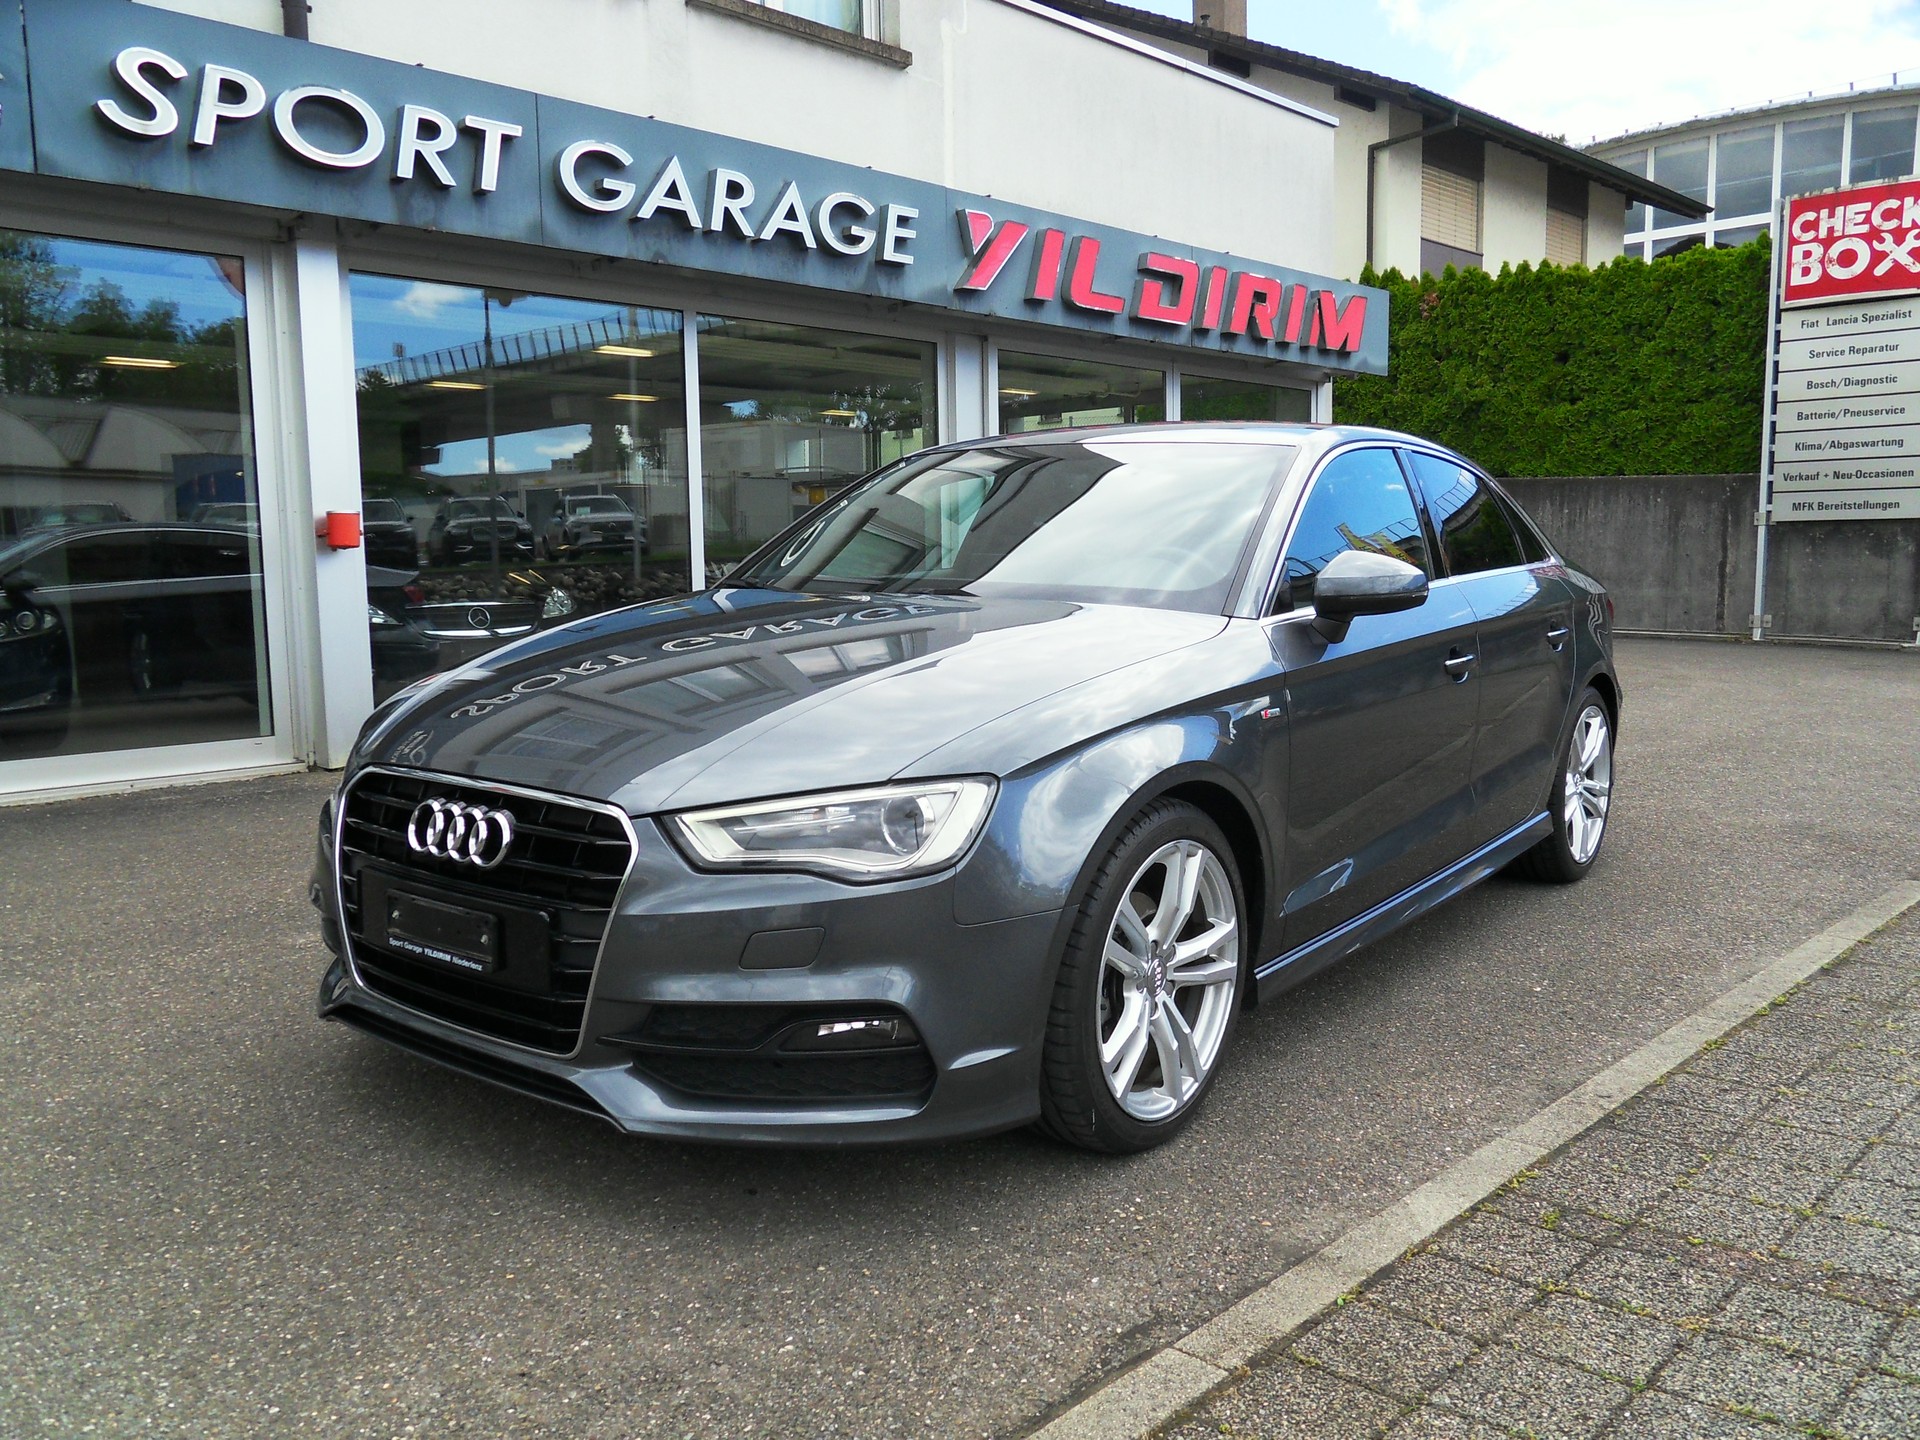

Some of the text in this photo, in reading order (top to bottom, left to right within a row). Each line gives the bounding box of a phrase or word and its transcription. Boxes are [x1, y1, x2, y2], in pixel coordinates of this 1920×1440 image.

[95, 46, 1368, 353] SPORT GARAGE YILDIRIM
[1791, 196, 1920, 242] CHECK
[1800, 309, 1912, 329] Fiat Lancia Spezialist
[1808, 343, 1900, 359] Service Reparatur
[1806, 374, 1898, 390] Bosch/Diagnostic
[1796, 405, 1906, 421] Batterie/Pneuservice
[1794, 438, 1904, 452] Klima/Abgaswartung
[1782, 471, 1820, 482] Verkauf
[1832, 469, 1914, 480] Neu-Occasionen
[1791, 501, 1900, 513] MFK Bereitstellungen
